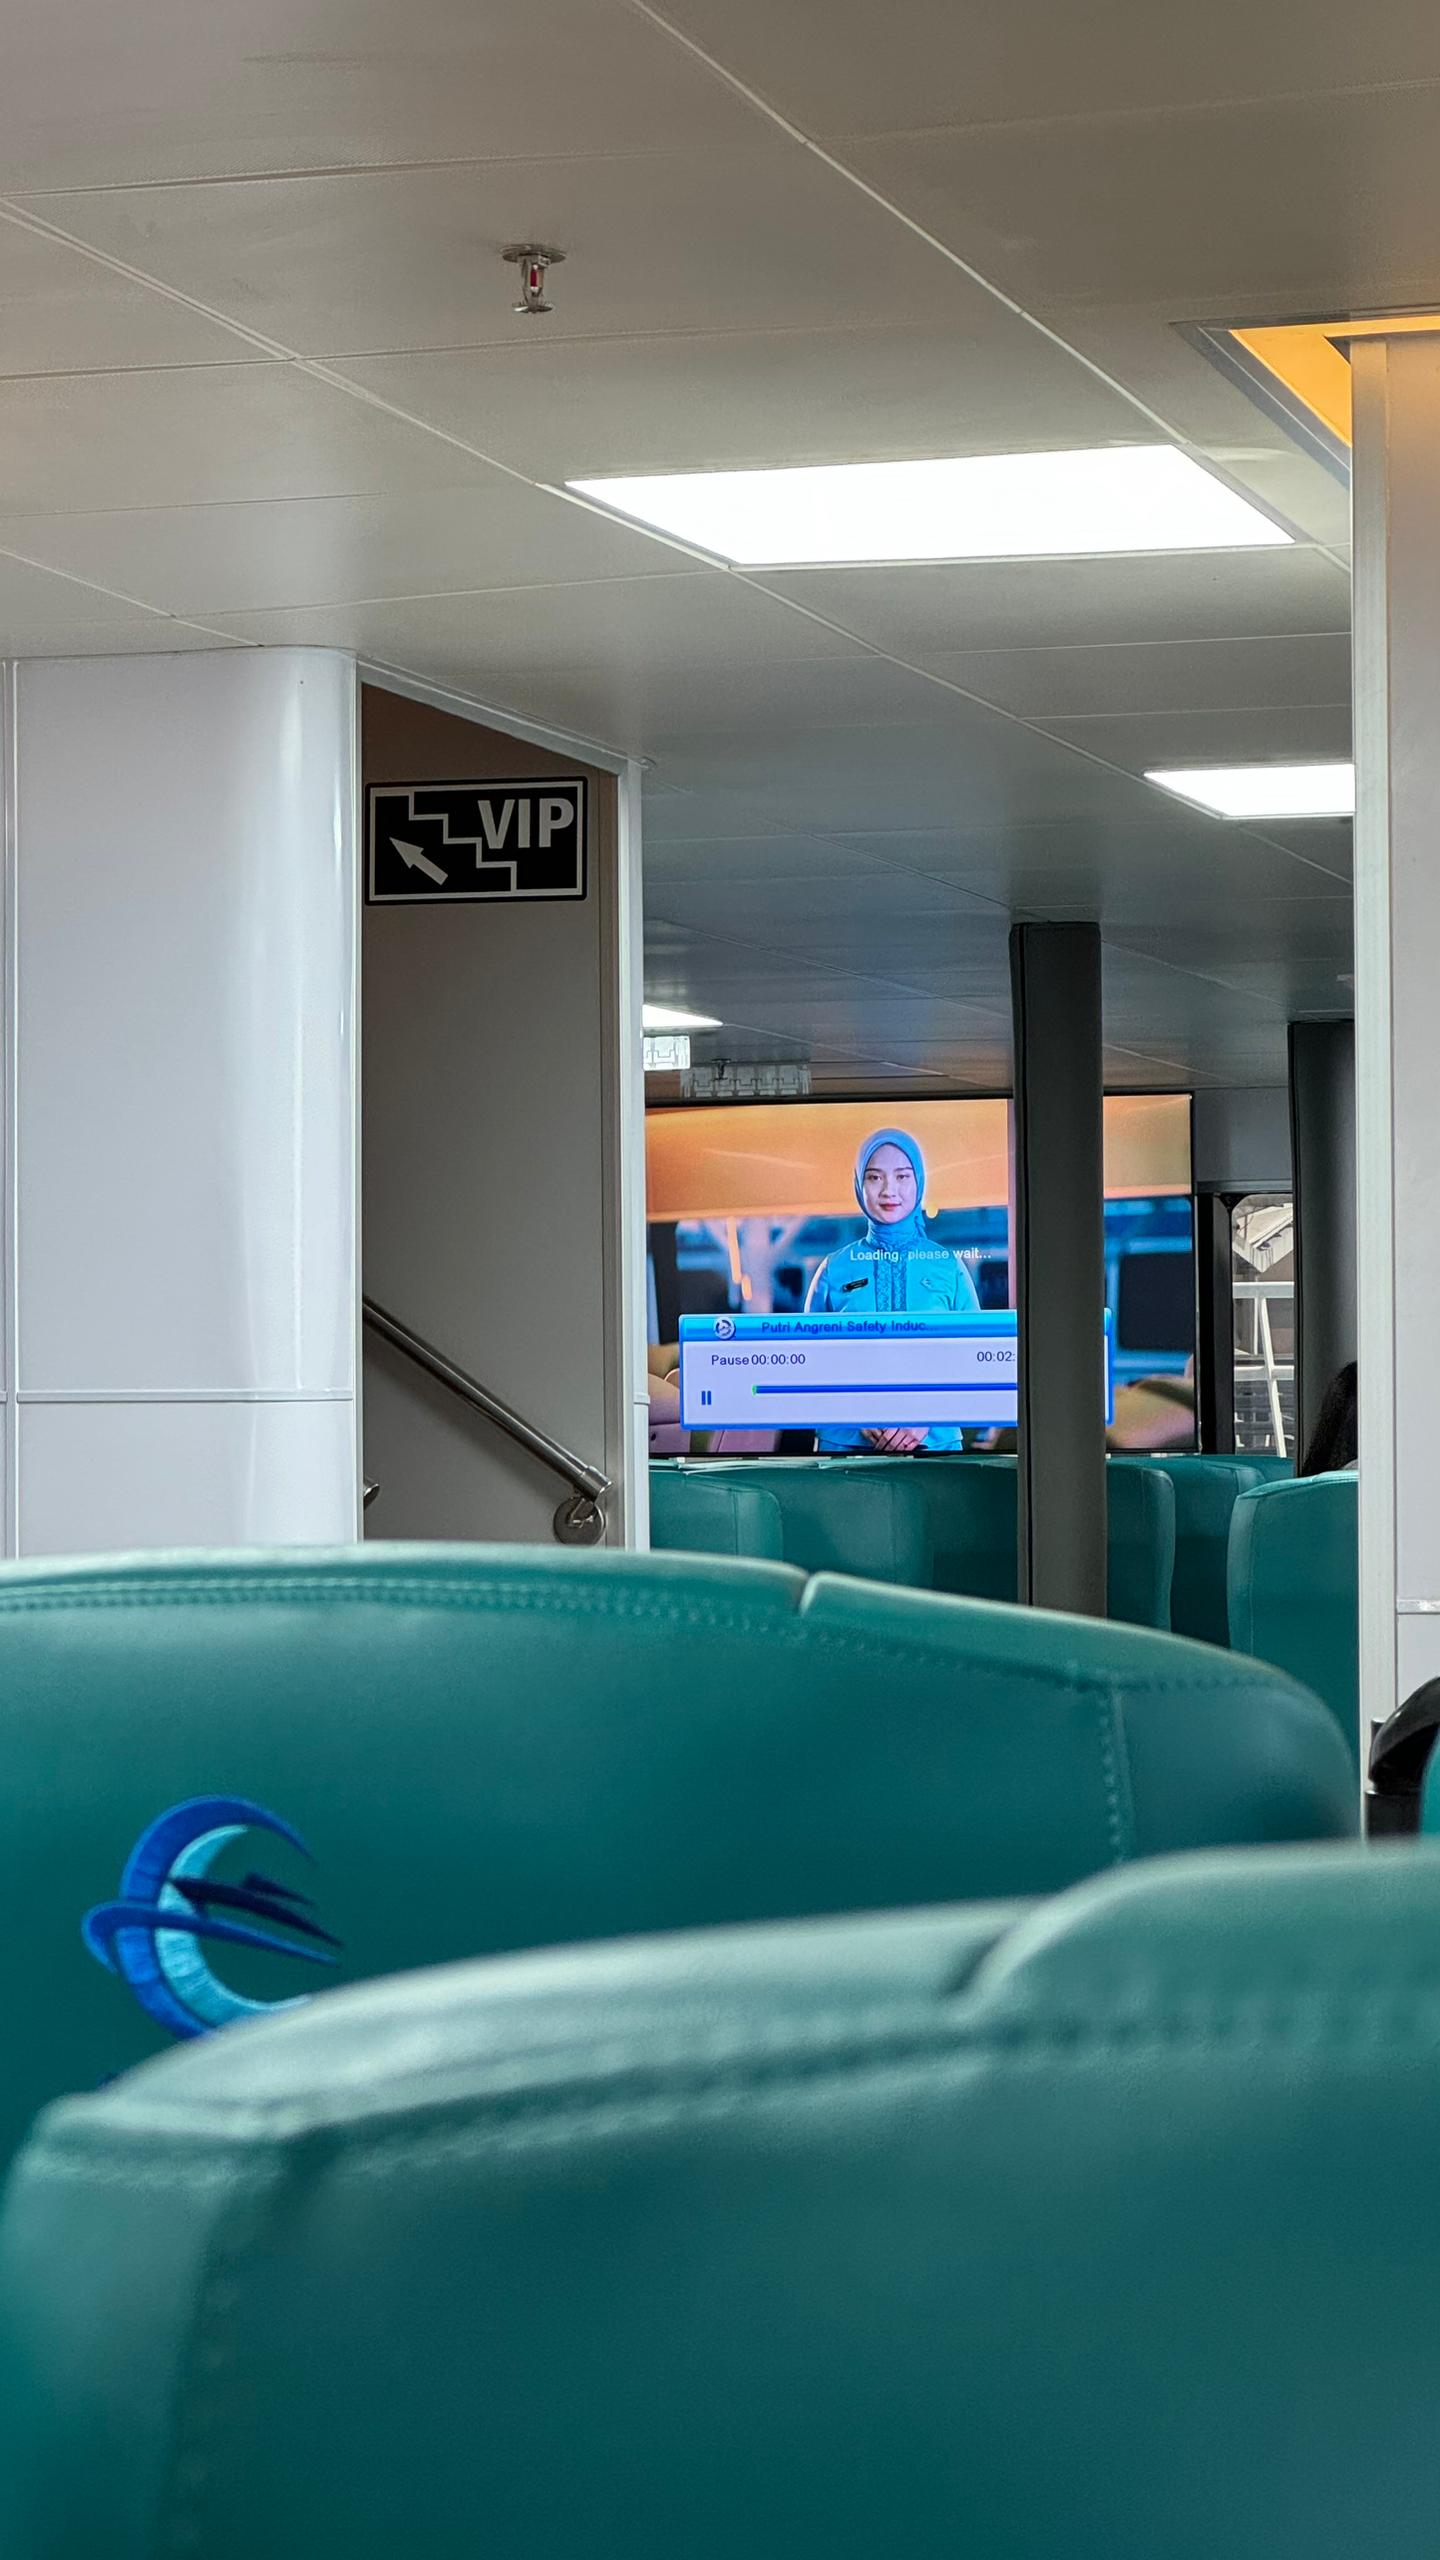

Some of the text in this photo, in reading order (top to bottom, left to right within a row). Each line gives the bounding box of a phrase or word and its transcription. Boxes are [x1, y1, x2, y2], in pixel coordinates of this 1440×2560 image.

[477, 797, 575, 850] VIP
[907, 1249, 950, 1261] please
[952, 1247, 992, 1260] wait...
[761, 1321, 791, 1333] Putri
[793, 1320, 842, 1334] Angreni
[847, 1320, 887, 1334] Safety
[711, 1353, 806, 1366] Pause 00:00:00
